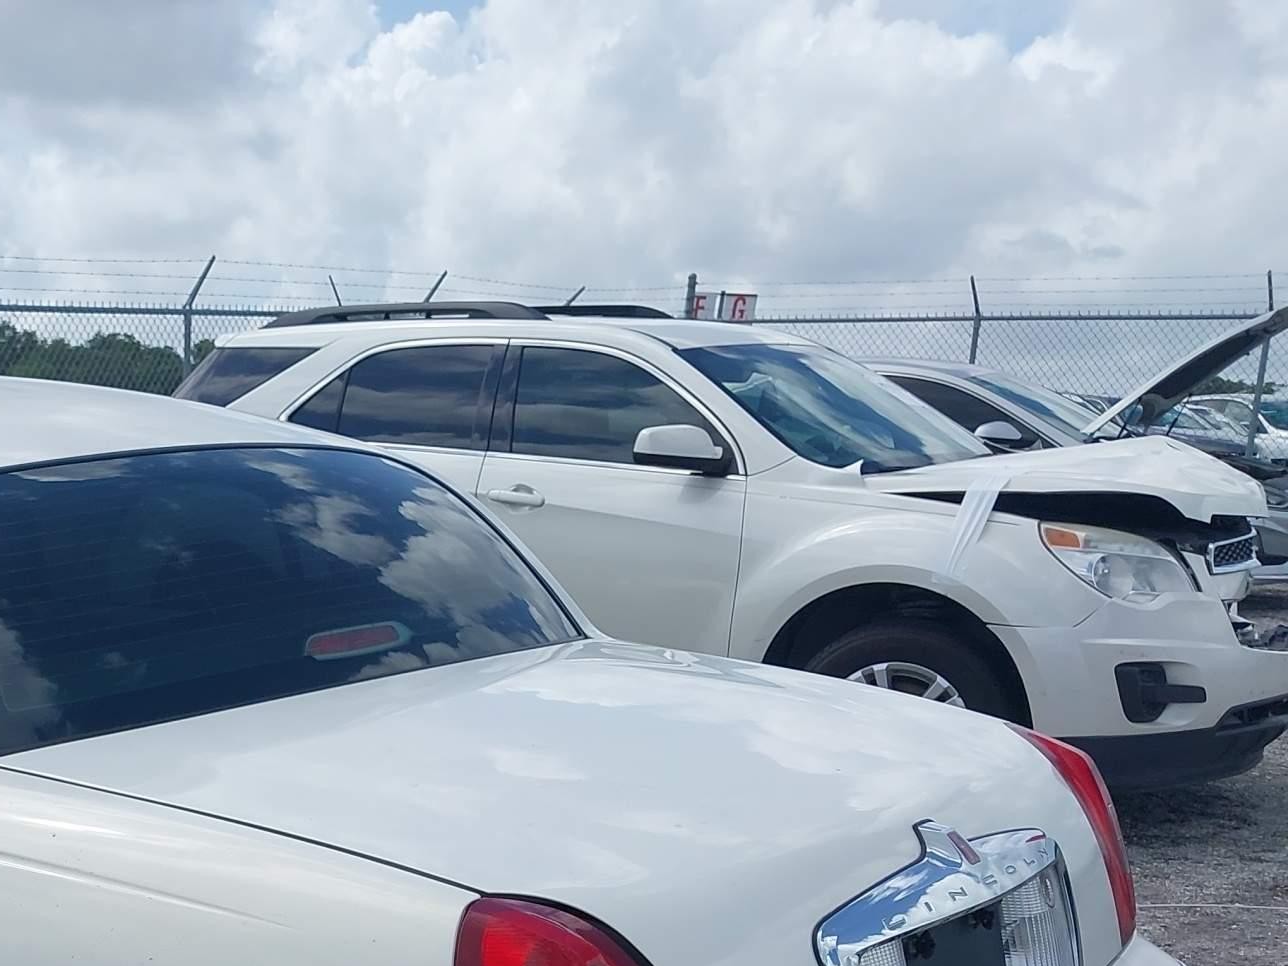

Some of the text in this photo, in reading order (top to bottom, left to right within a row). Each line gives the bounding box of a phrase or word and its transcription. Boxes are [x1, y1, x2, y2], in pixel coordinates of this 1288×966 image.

[694, 295, 707, 319] F
[732, 295, 746, 319] G
[881, 847, 1049, 931] LINCOLN
